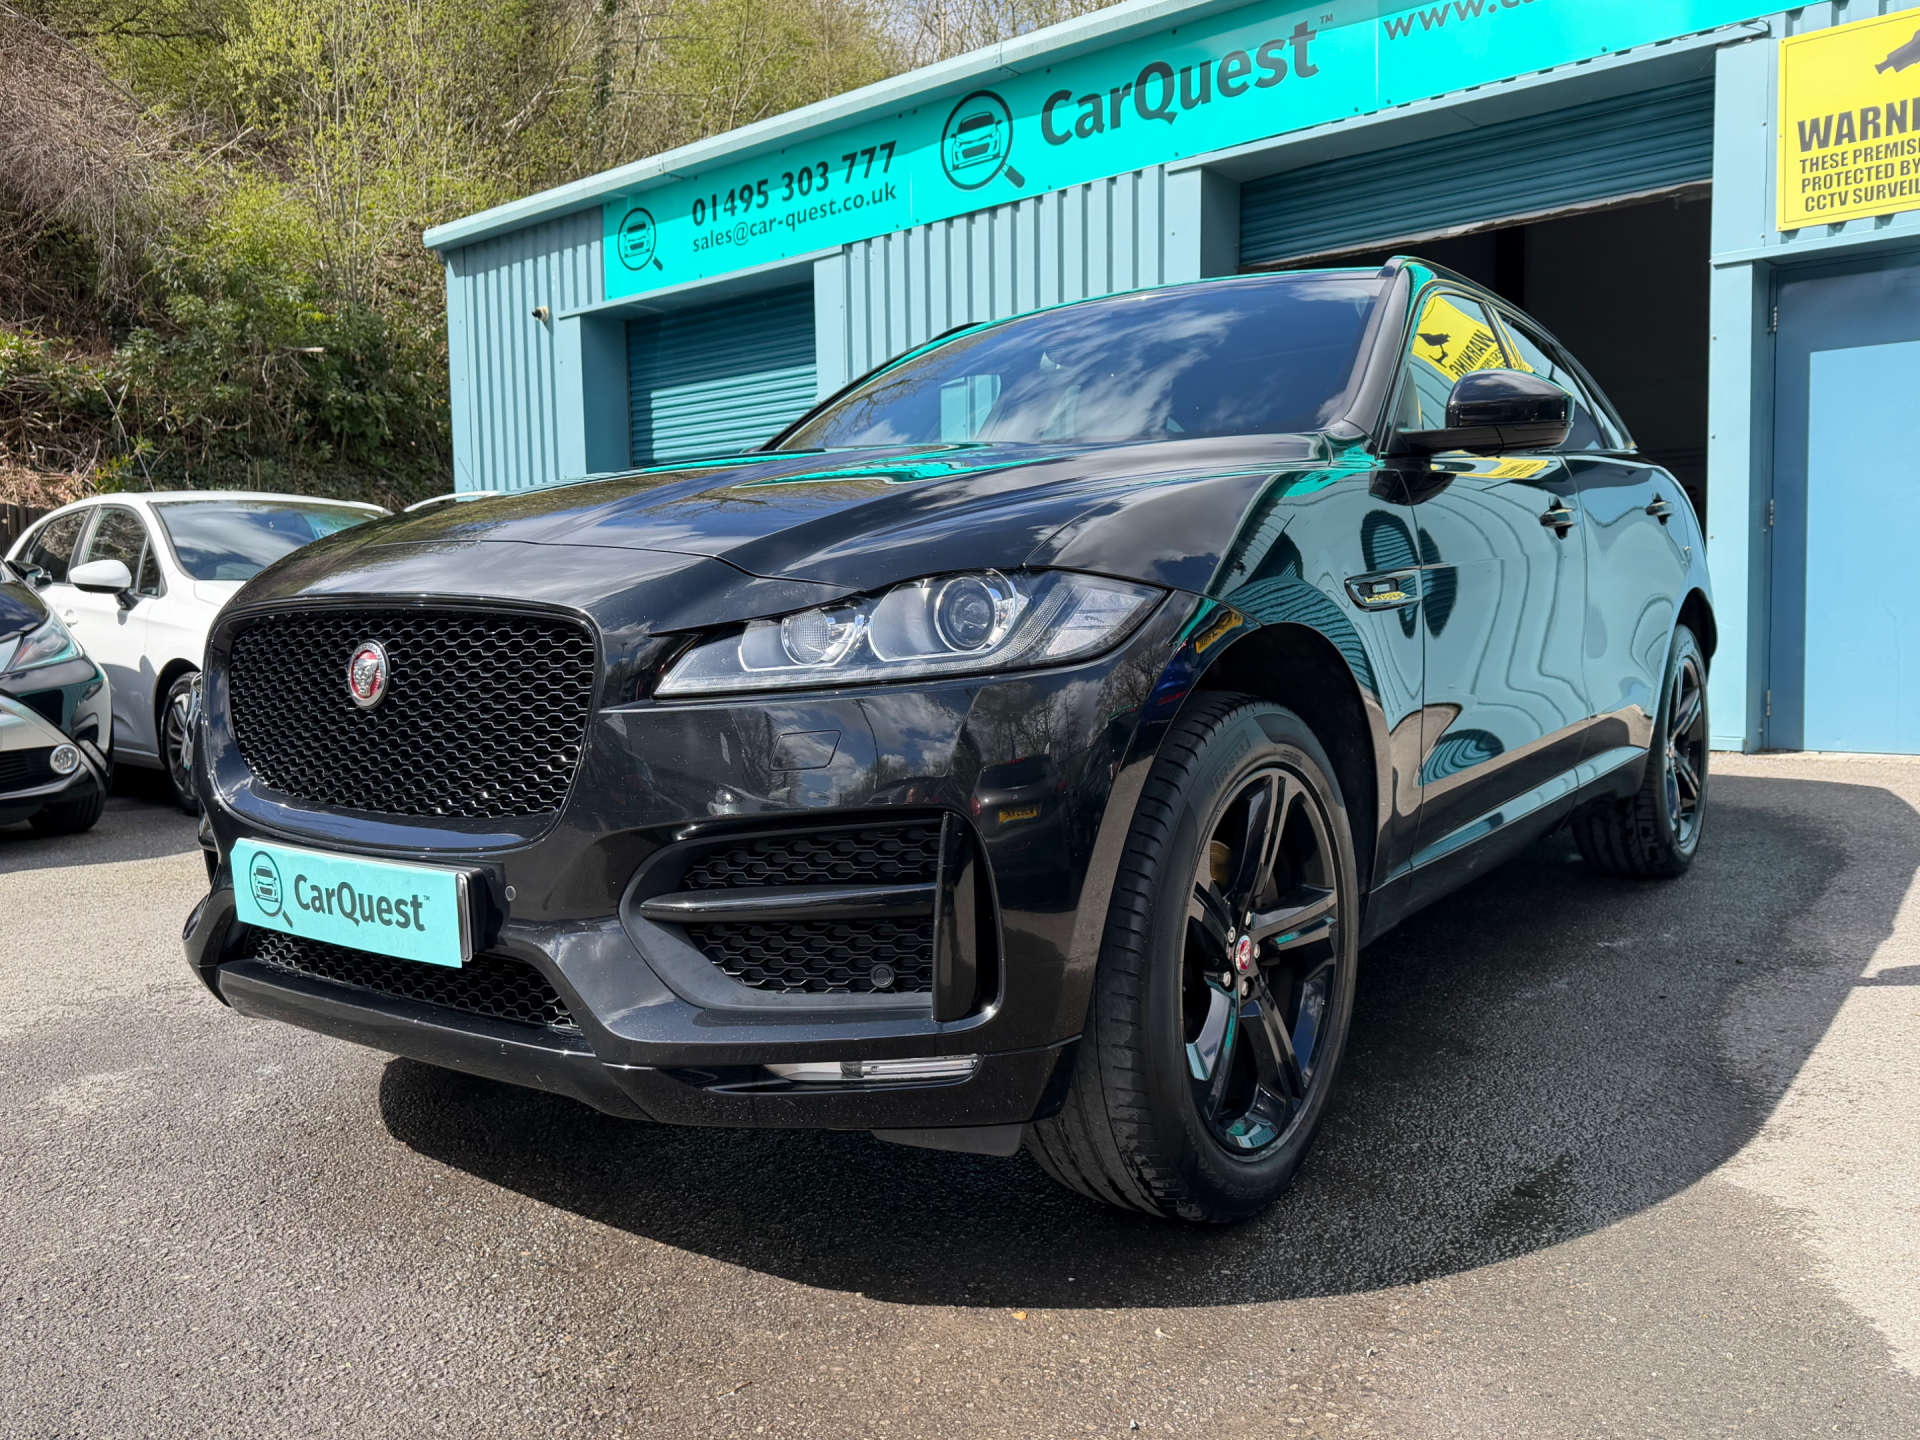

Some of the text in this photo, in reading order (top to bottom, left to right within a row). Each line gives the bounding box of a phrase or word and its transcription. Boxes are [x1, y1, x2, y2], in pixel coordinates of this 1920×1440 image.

[1041, 20, 1319, 146] CarQuest
[692, 141, 897, 227] 01495 303 777
[1800, 137, 1920, 174] THESE PREMIS
[1801, 157, 1920, 194] PROTECTED BY
[693, 182, 897, 252] sales@car-quest.co.uk
[1805, 190, 1849, 213] CCTV
[294, 873, 426, 932] CarQuest
